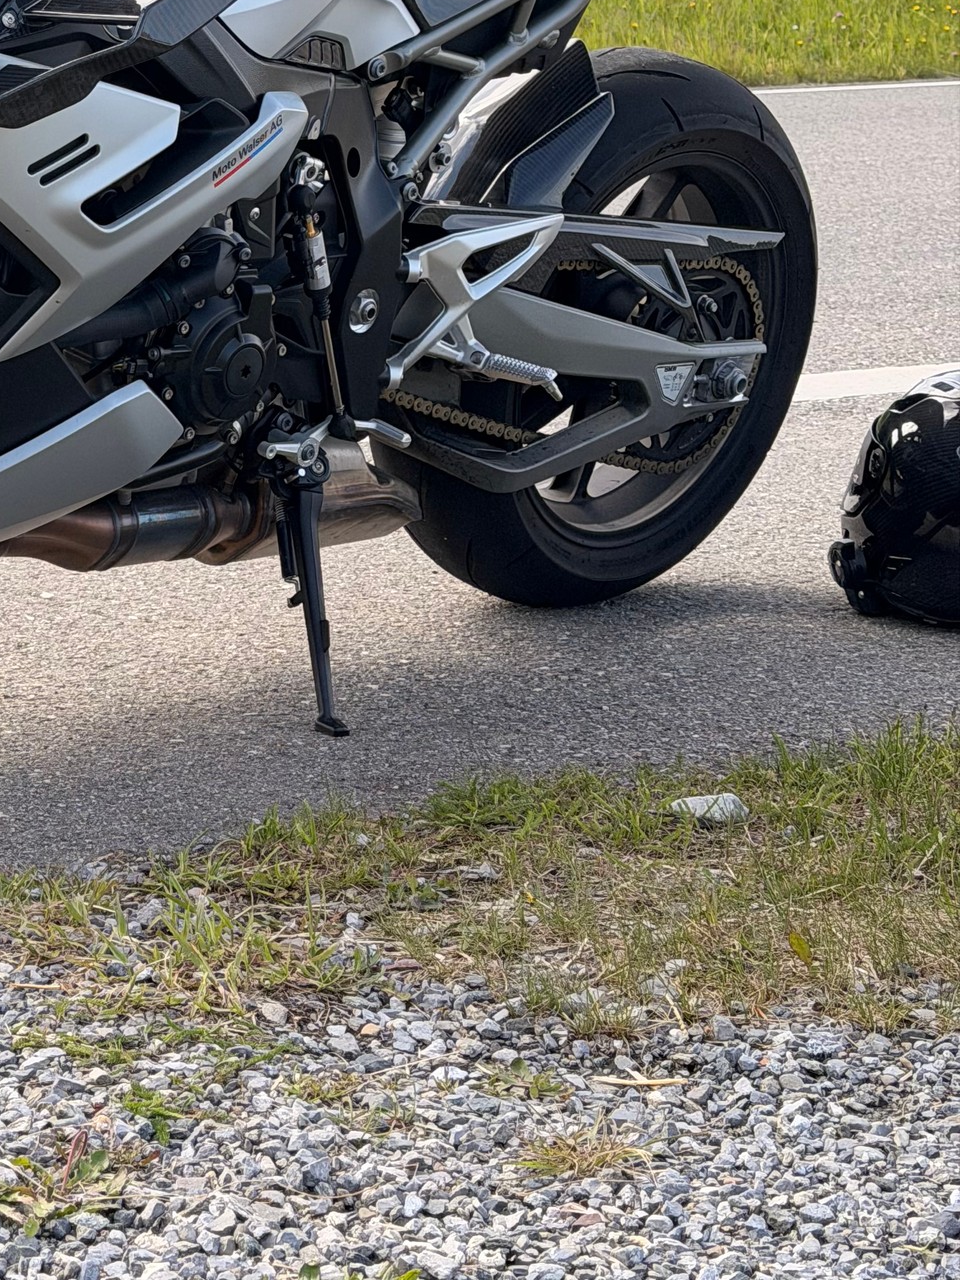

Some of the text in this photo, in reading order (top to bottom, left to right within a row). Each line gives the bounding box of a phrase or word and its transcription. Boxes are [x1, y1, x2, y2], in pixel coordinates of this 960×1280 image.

[212, 114, 283, 181] Moto Walser AG
